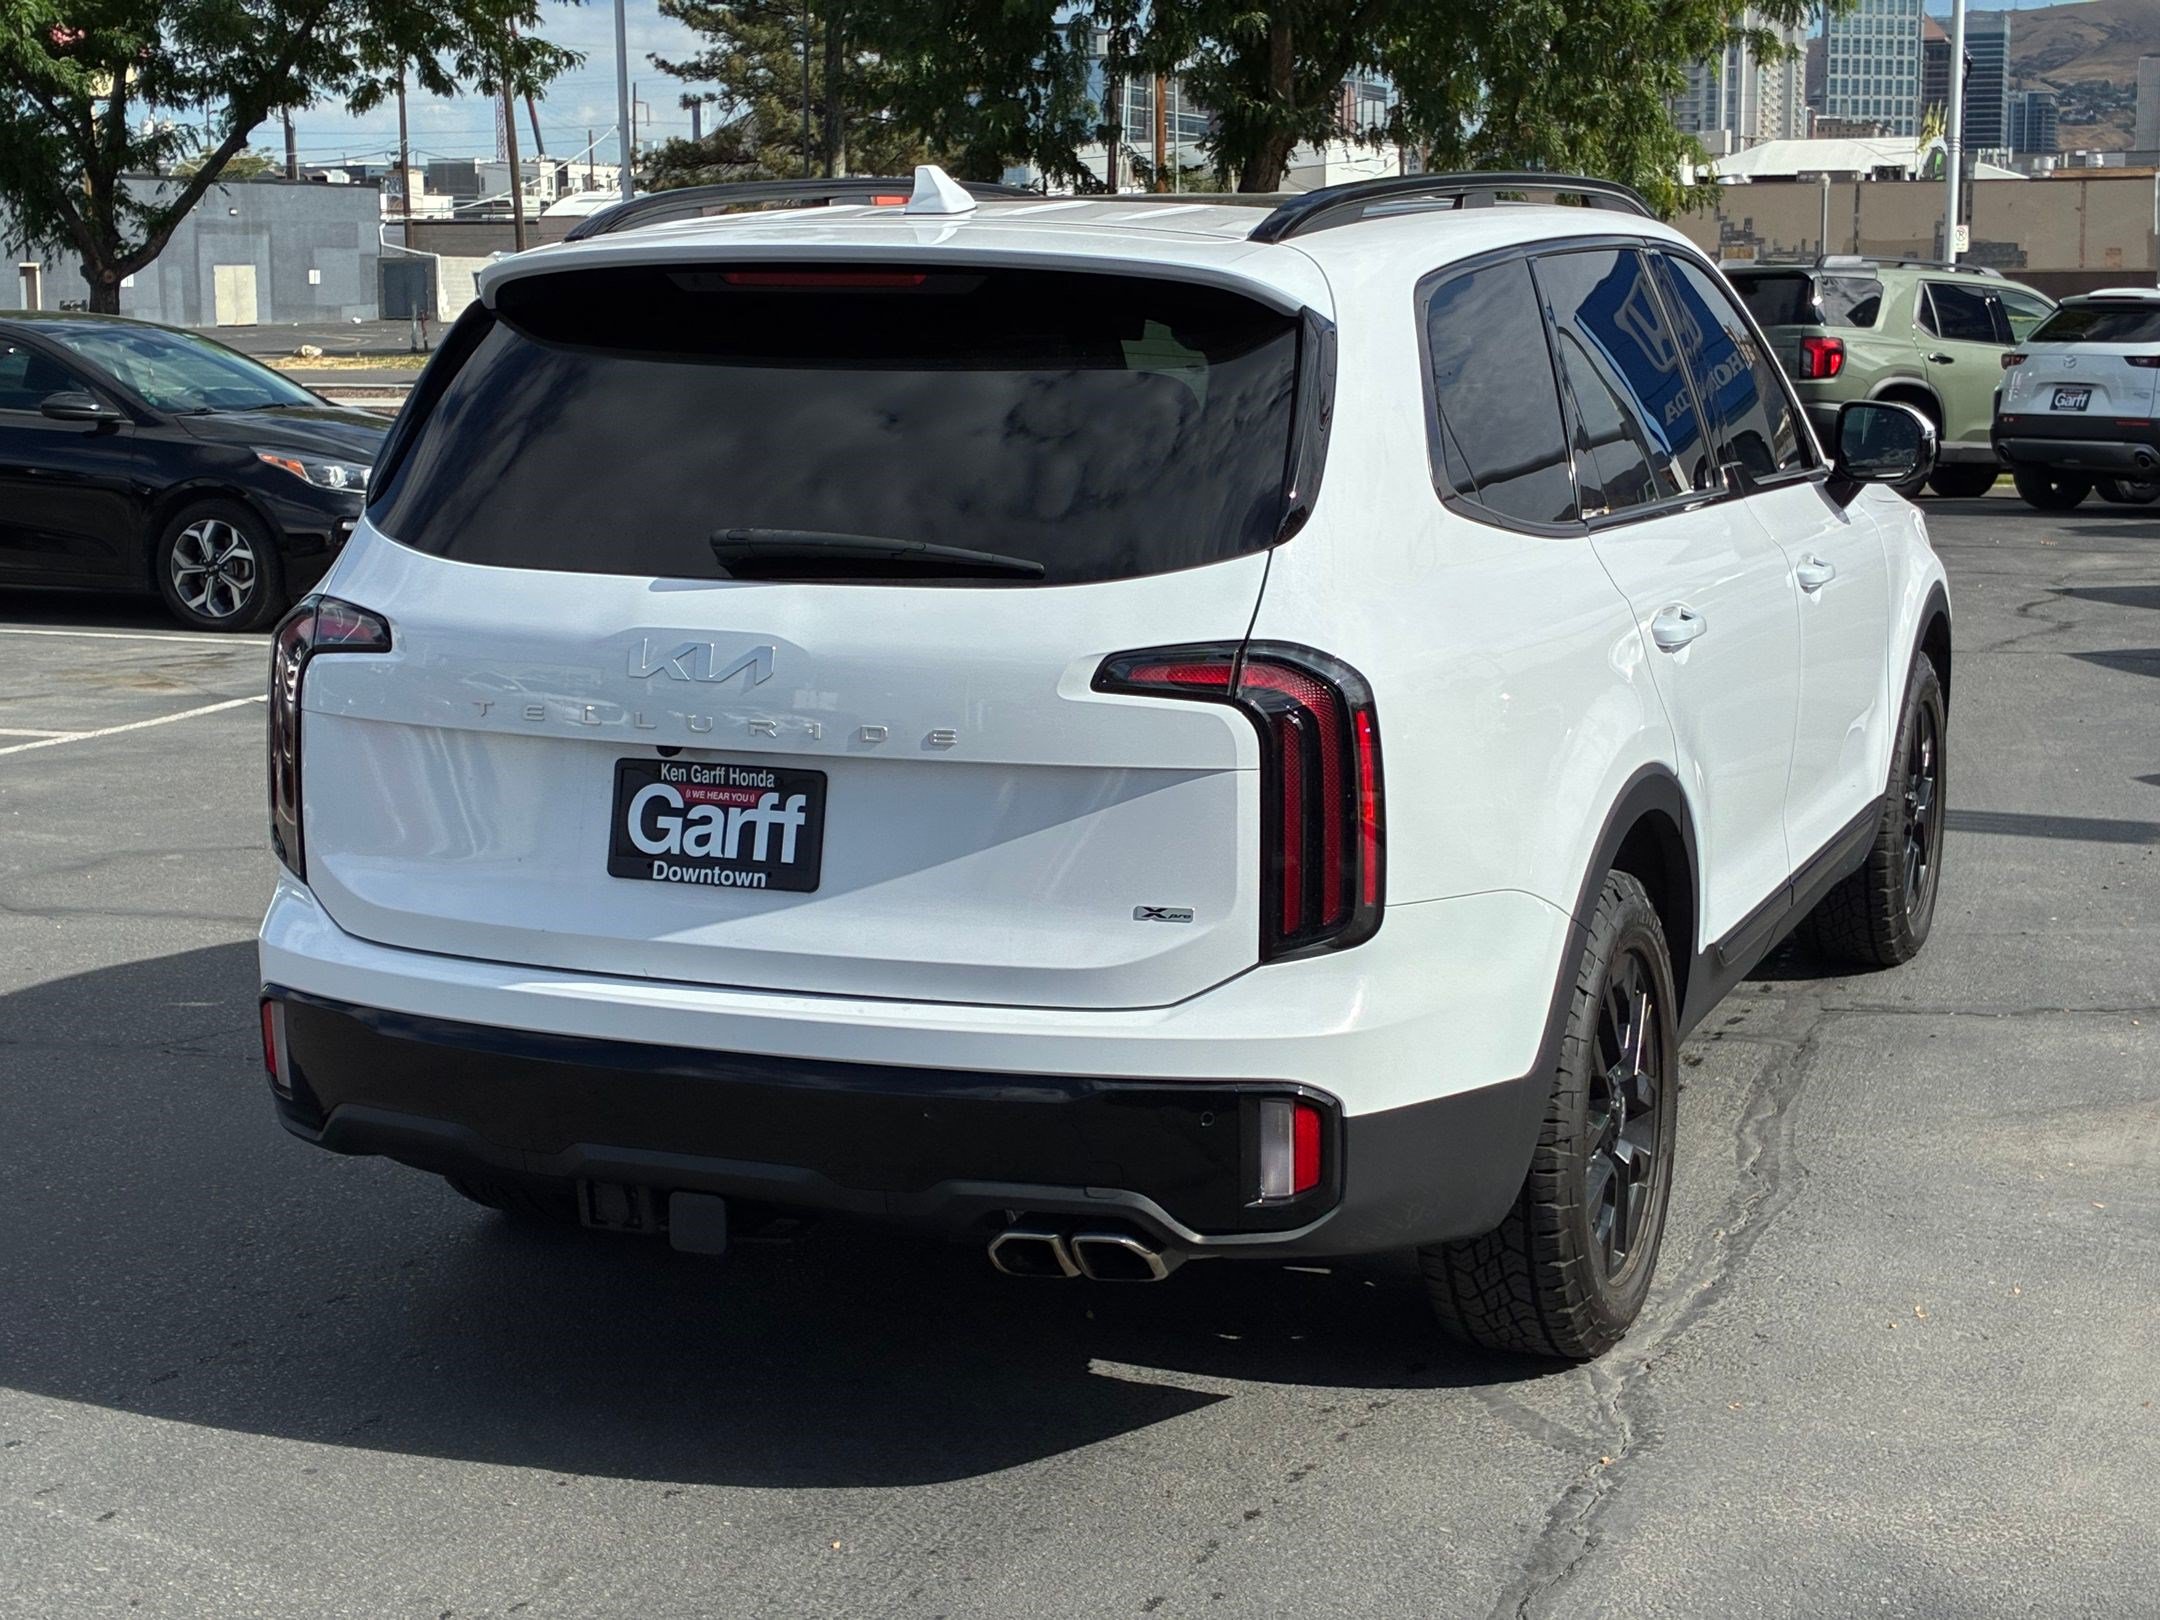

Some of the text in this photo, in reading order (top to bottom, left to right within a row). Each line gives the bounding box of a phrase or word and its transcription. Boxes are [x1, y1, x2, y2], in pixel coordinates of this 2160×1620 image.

[2055, 392, 2088, 407] Garff
[472, 701, 957, 745] TELLURIDE
[661, 763, 775, 788] Ken Garff Honda
[692, 790, 749, 802] WE HEAR YOU
[627, 783, 806, 864] Garff
[652, 861, 766, 888] Downtown
